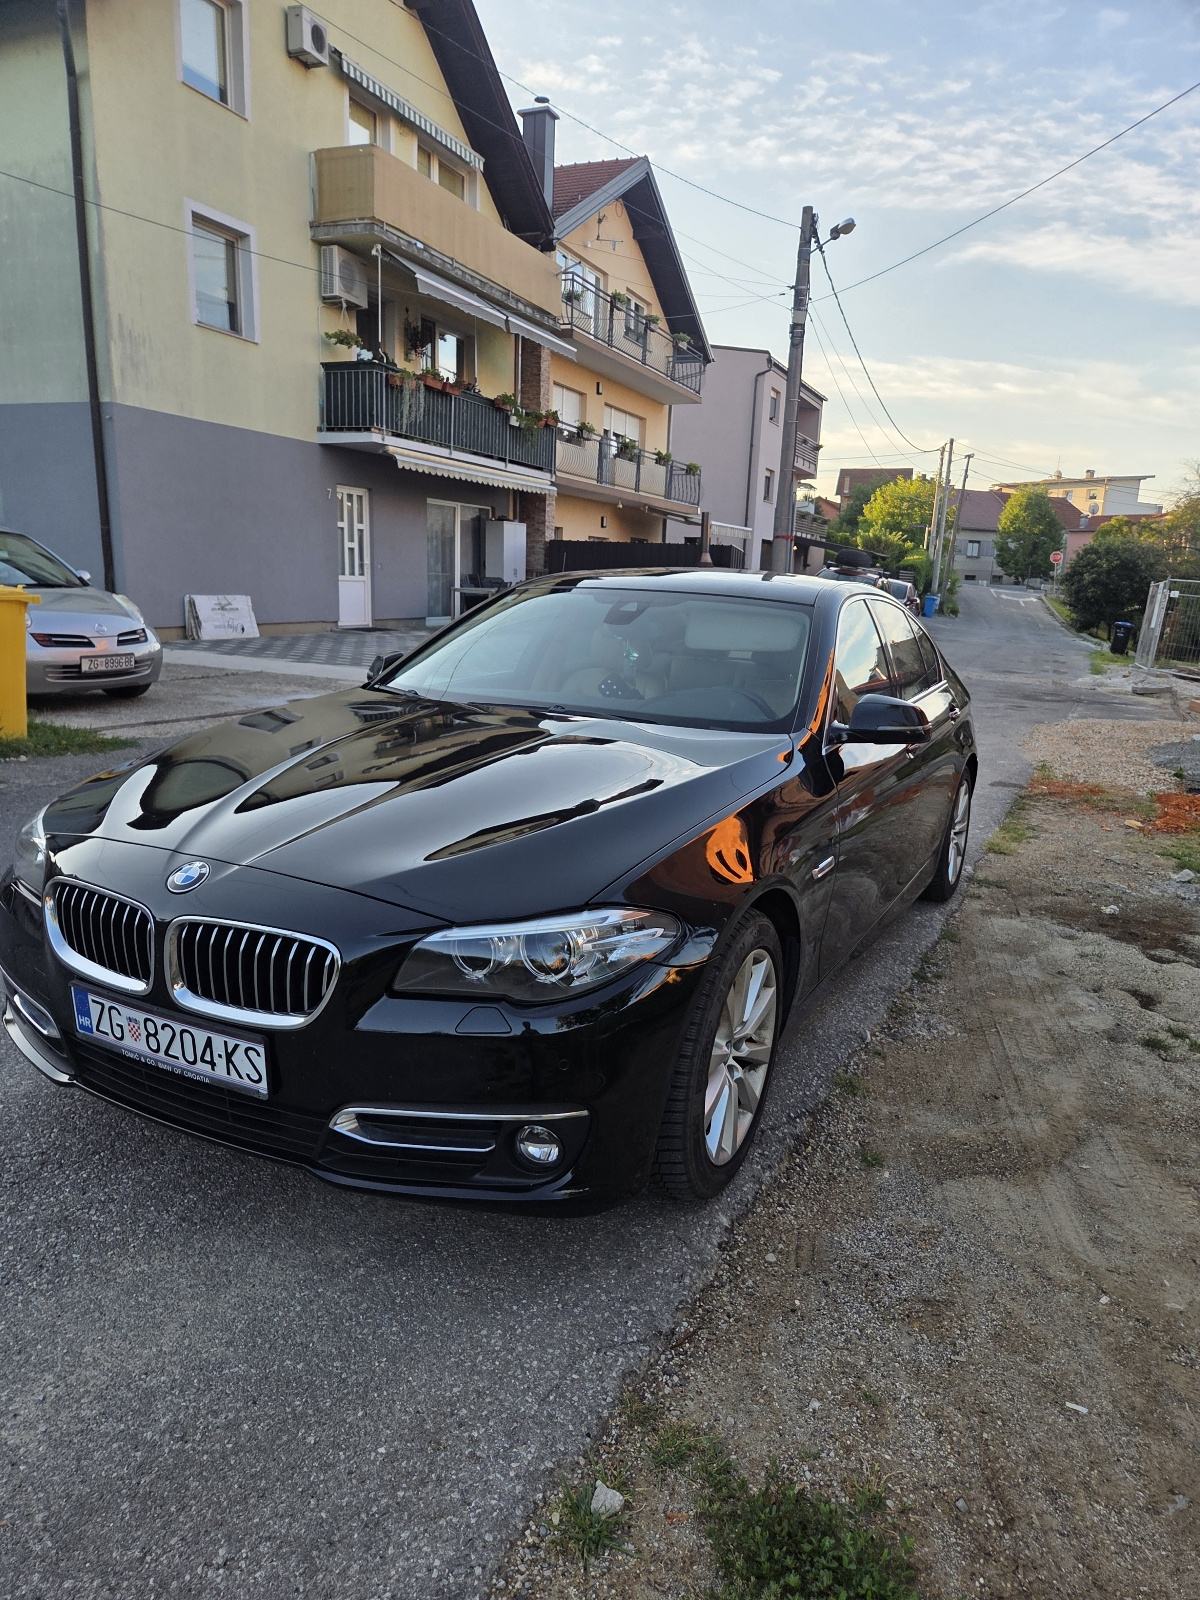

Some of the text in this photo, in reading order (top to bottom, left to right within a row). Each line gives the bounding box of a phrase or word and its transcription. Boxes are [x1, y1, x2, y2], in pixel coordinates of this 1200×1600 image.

[88, 659, 99, 670] ZG
[78, 1015, 92, 1028] HR
[91, 999, 125, 1041] ZG
[173, 1067, 182, 1075] OF
[183, 1070, 210, 1084] CROATIA
